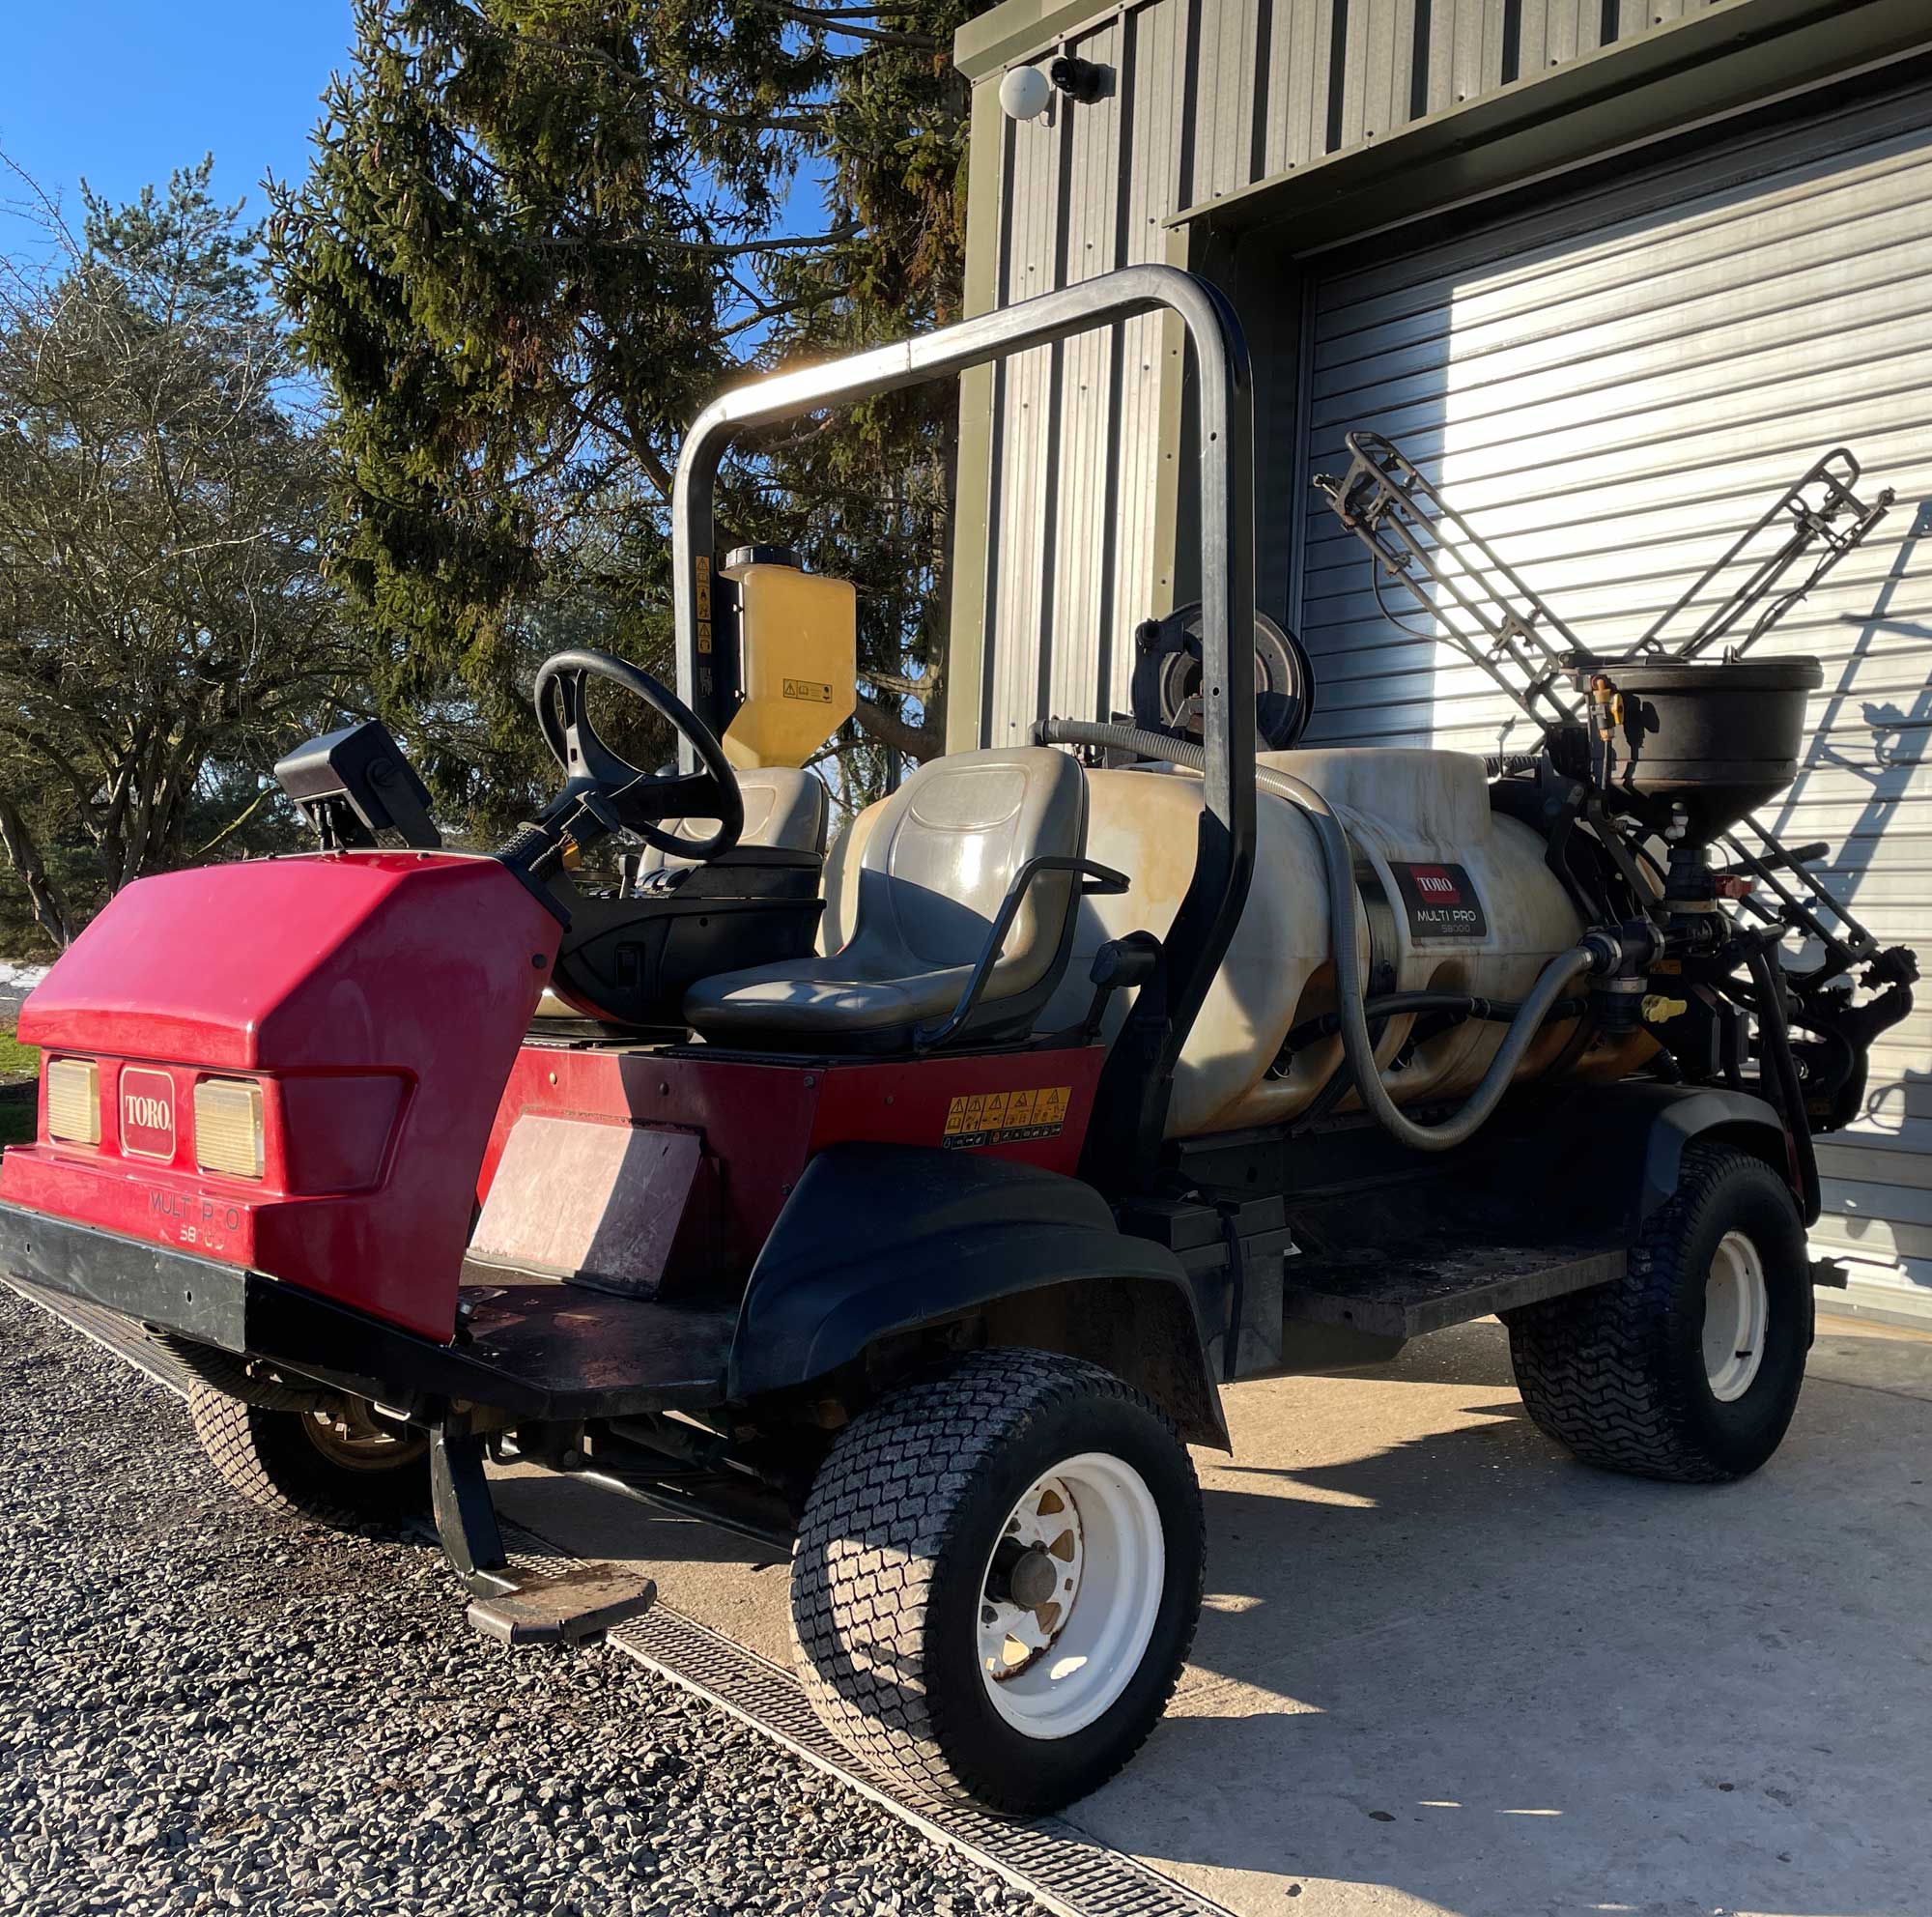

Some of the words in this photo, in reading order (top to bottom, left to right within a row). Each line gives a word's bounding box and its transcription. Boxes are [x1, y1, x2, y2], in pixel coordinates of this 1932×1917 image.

[1416, 876, 1453, 892] TORO
[1417, 909, 1450, 922] MULTI
[1452, 909, 1477, 922] PRO
[125, 1095, 171, 1130] TORO
